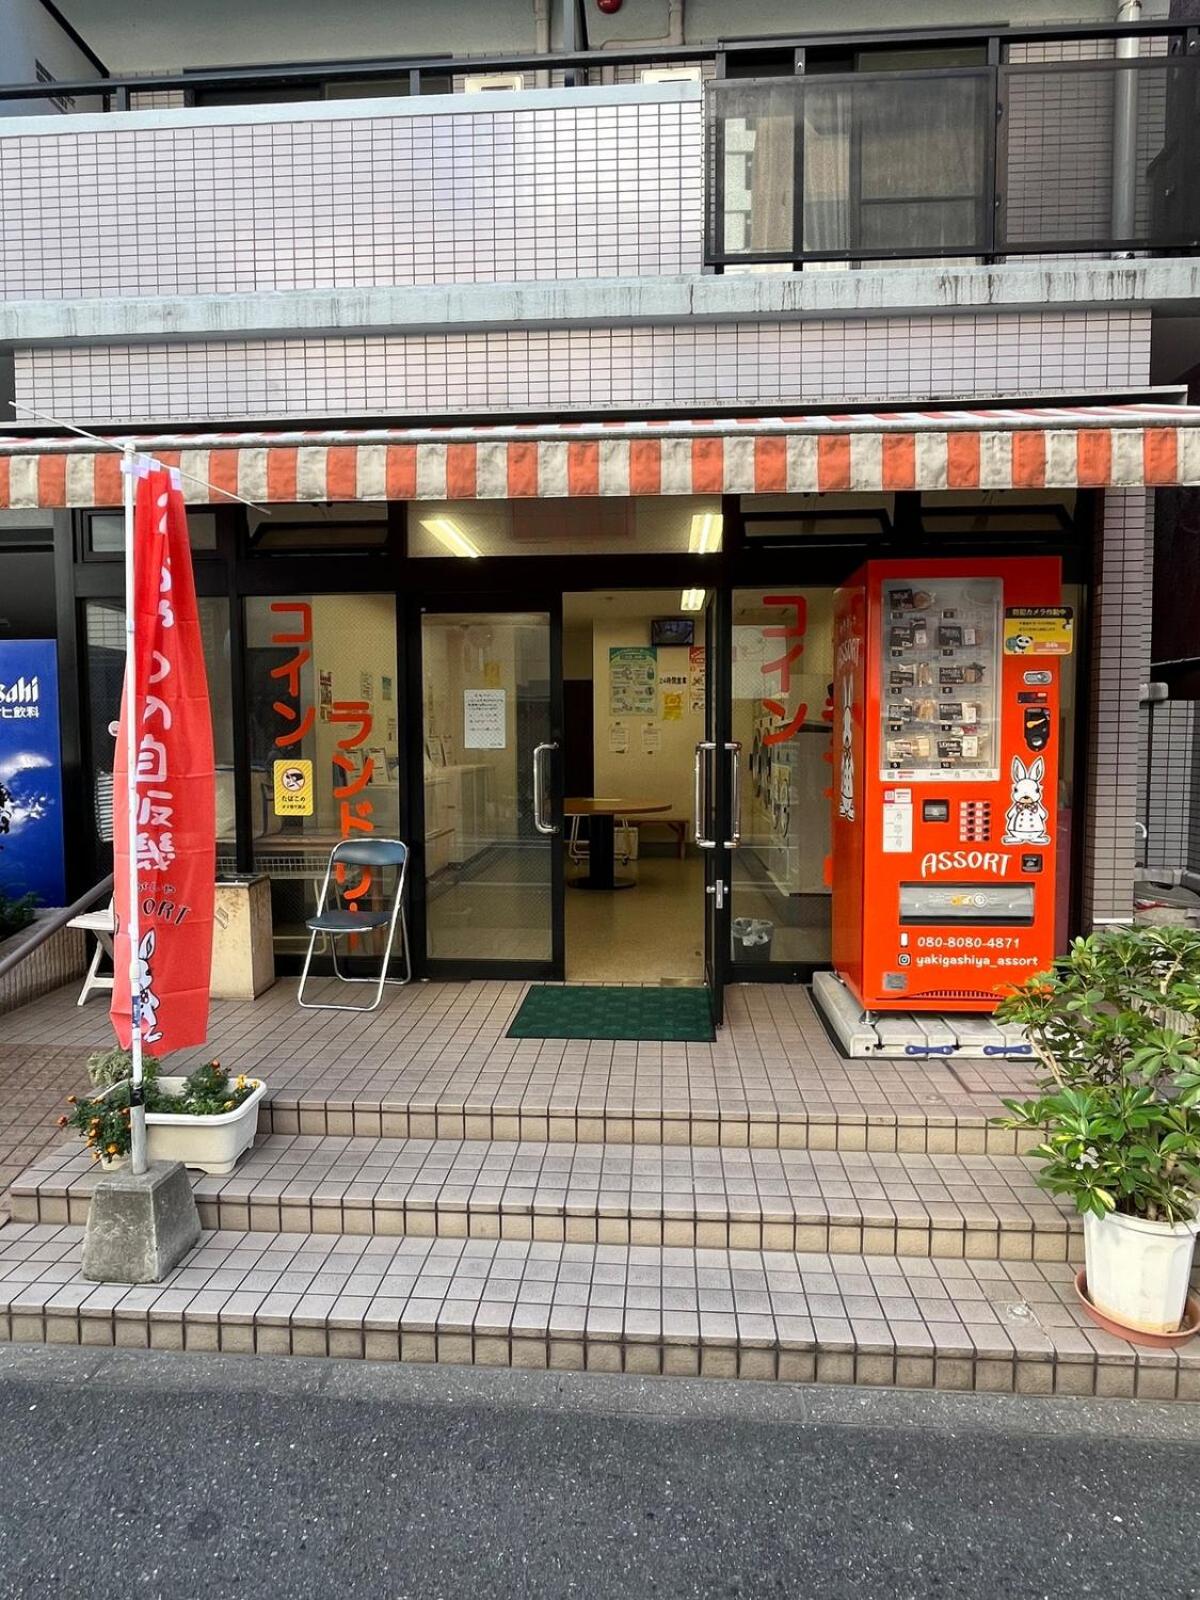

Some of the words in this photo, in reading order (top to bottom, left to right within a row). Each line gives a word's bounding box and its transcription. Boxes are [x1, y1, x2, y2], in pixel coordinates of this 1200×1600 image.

[270, 602, 316, 748] コイン
[761, 595, 808, 746] コイン
[0, 705, 39, 719] ヒ飲料
[921, 850, 1012, 878] ASSORT
[917, 936, 1020, 949] 080-8080-4871
[916, 954, 1039, 968] yakigashiya_assort
